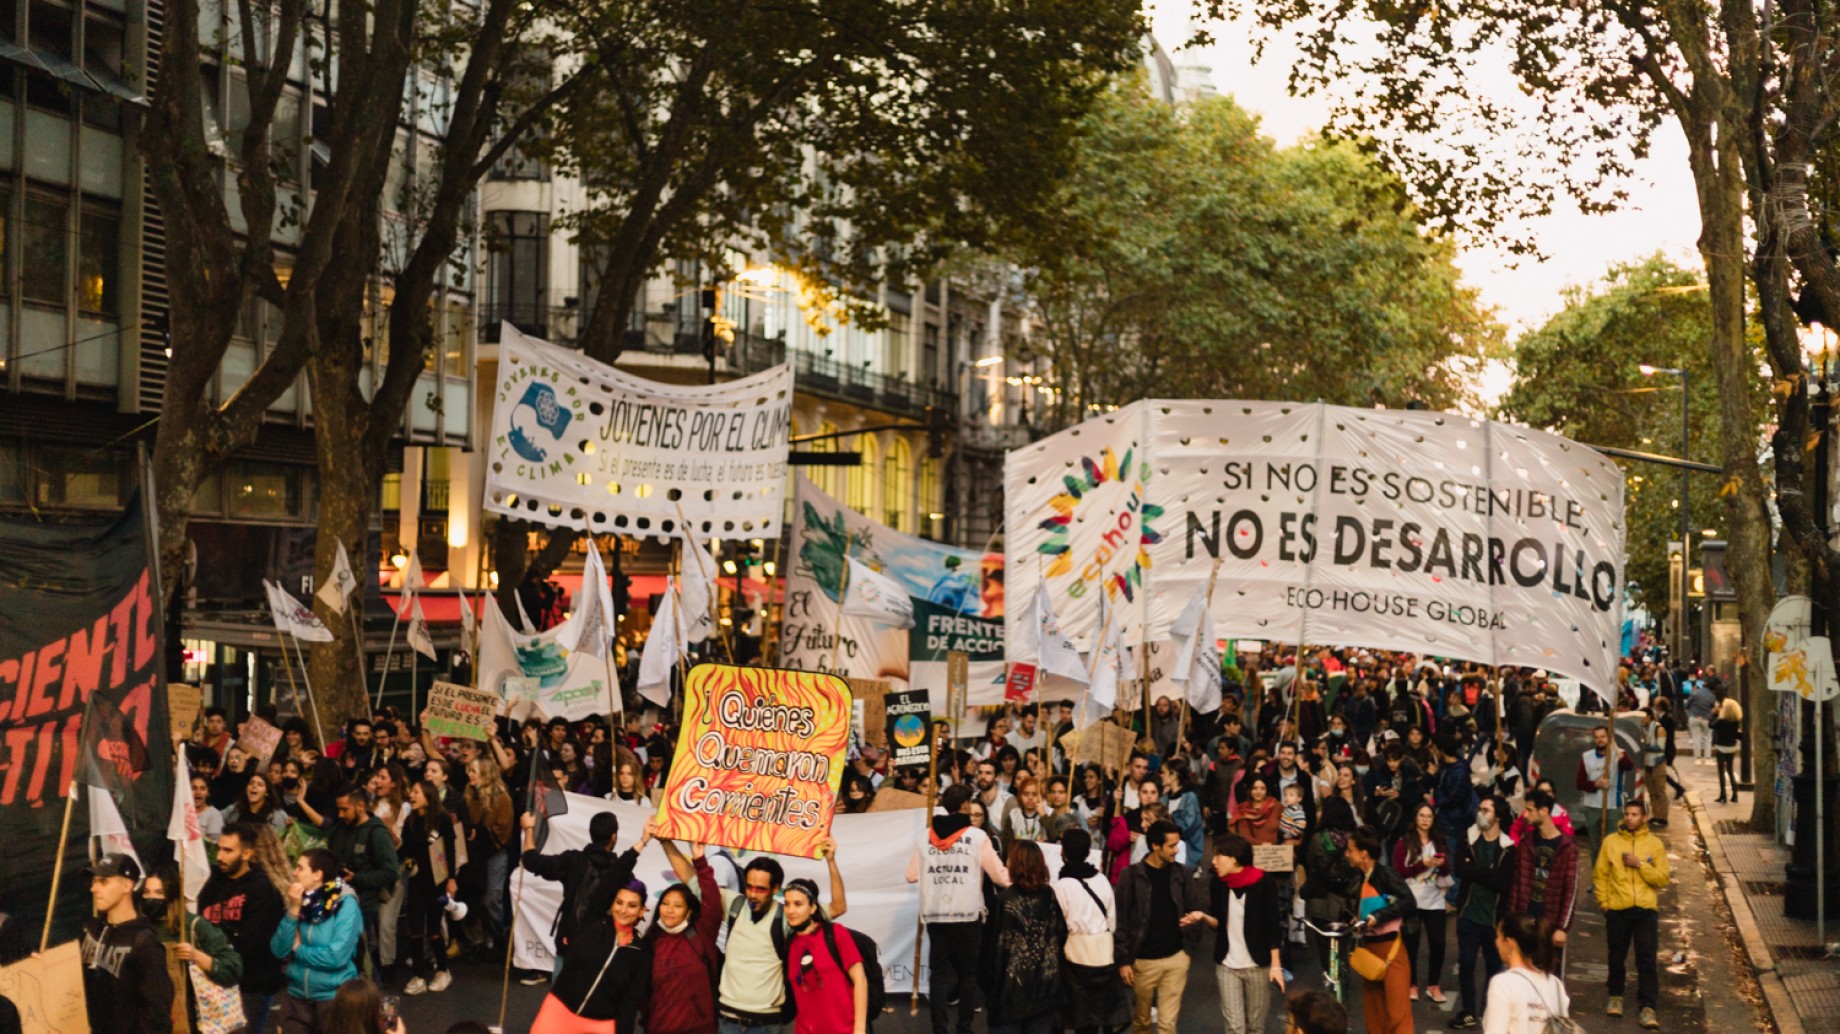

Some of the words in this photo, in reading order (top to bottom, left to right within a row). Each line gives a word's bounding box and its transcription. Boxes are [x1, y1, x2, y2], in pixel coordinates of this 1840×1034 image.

[499, 365, 559, 402] JOVENES
[565, 386, 585, 421] POR
[600, 394, 687, 449] JÓVENES
[687, 410, 726, 451] POR
[725, 413, 746, 452] EL
[496, 435, 509, 460] EL
[516, 452, 574, 480] CLIMA
[622, 457, 661, 482] presente
[664, 464, 675, 480] es
[677, 458, 688, 481] de
[717, 459, 726, 482] el
[1223, 462, 1252, 490] SI
[1267, 462, 1318, 492] NO
[1330, 465, 1370, 496] ES
[1383, 472, 1589, 537] SOSTENIBLE,
[1185, 509, 1264, 559] NO
[1279, 512, 1319, 564] ES
[1334, 515, 1616, 612] DESARROLLO
[789, 590, 812, 618] El
[1287, 586, 1418, 618] ECO-HOUSE
[1427, 600, 1507, 630] GLOBAL
[928, 615, 1004, 638] FRENTE
[784, 622, 858, 658] Futuro
[927, 635, 949, 650] DE
[433, 684, 444, 695] SI
[444, 687, 455, 698] EL
[458, 689, 498, 707] PRESENTE
[900, 694, 911, 705] EL
[430, 705, 463, 721] FUTURO
[465, 714, 480, 726] ES
[454, 702, 481, 714] LUCHA
[481, 705, 492, 716] EL
[696, 731, 829, 784] Quemaron
[927, 865, 969, 874] ACTUAR
[933, 876, 964, 885] LOCAL
